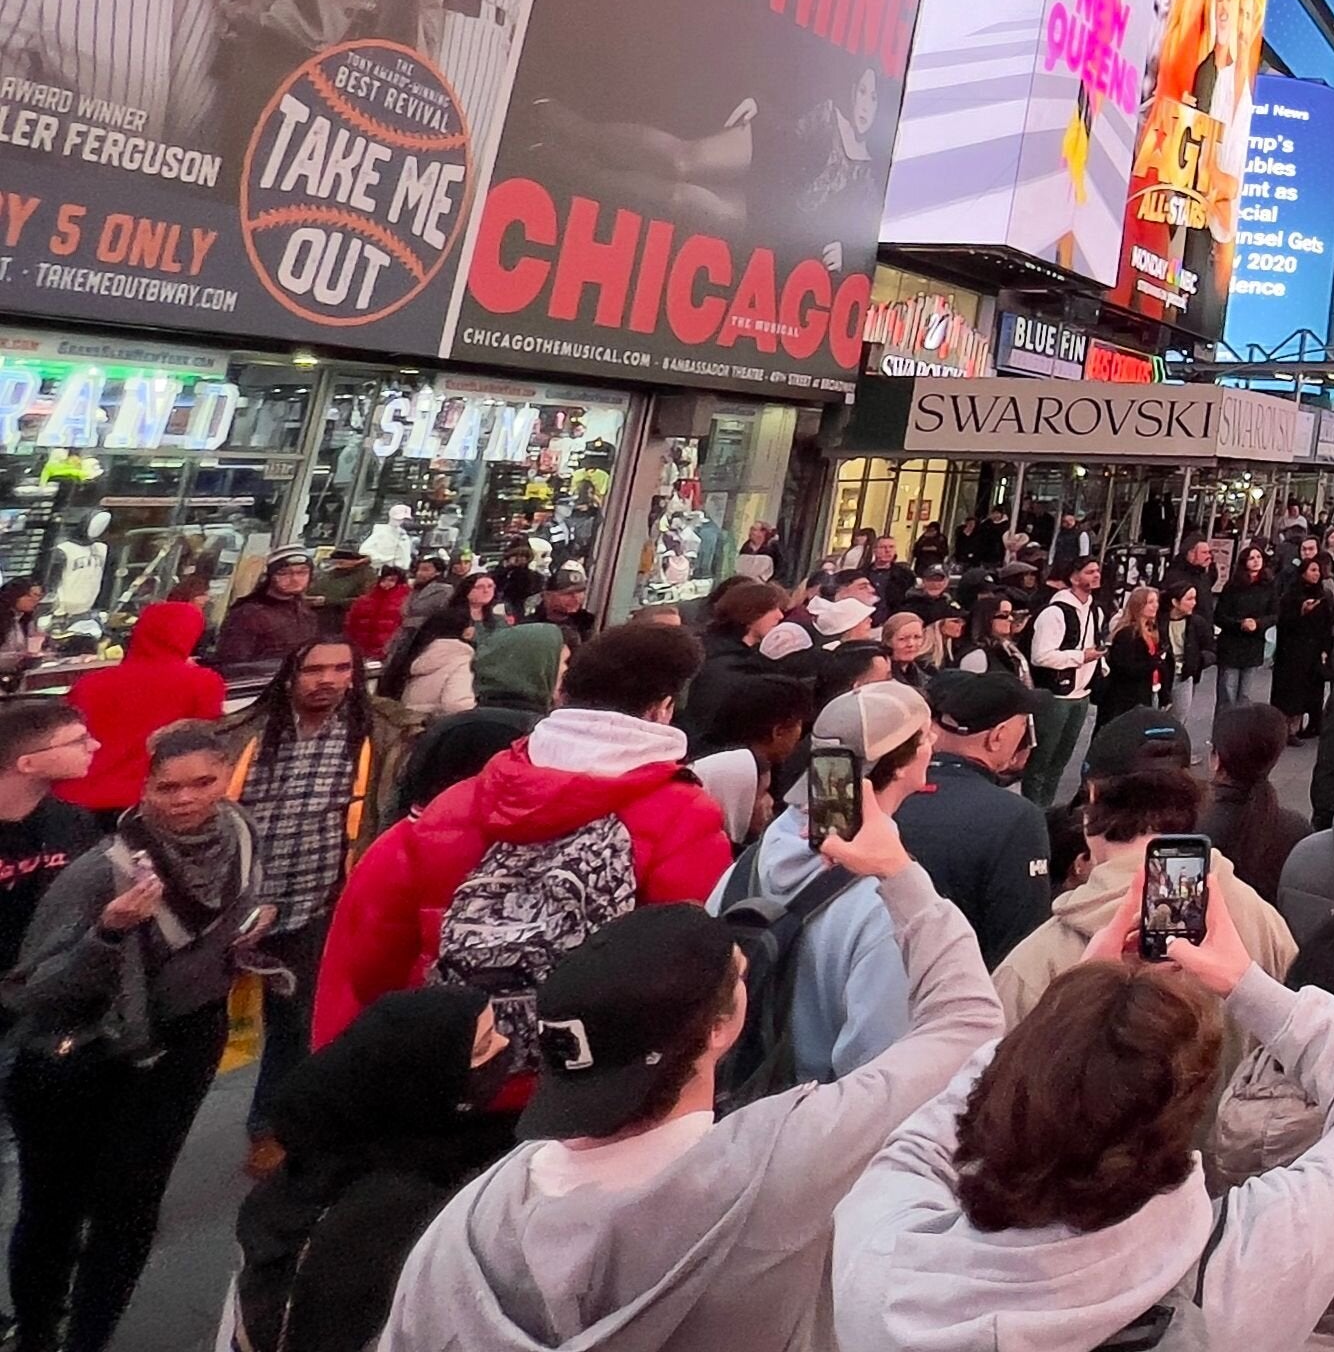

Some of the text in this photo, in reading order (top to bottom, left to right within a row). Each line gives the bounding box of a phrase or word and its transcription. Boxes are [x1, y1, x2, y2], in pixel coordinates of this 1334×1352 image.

[1044, 2, 1138, 115] QUEENS
[1, 77, 148, 133] AWARD WINNER
[335, 65, 449, 134] BEST REVIVAL
[1273, 104, 1310, 121] News
[63, 122, 223, 188] FERGUSON
[260, 93, 467, 250] TAKE ME
[1238, 204, 1279, 223] cial
[1274, 185, 1299, 202] as
[50, 203, 87, 256] 5
[96, 213, 218, 276] ONLY
[1131, 244, 1168, 281] MONDAY
[1247, 252, 1298, 274] 2020
[1288, 232, 1325, 255] Gets
[36, 262, 239, 312] TAKEMEOUTBWAY.COM
[277, 227, 391, 311] OUT
[468, 177, 871, 369] CHICAGO
[463, 327, 651, 368] CHICAGOTHEMUSICAL.COM
[732, 315, 801, 339] THE MUSICAL
[1014, 318, 1087, 362] BLUE FIN
[373, 397, 540, 462] SLAM
[914, 394, 1214, 439] SWAROVSKI
